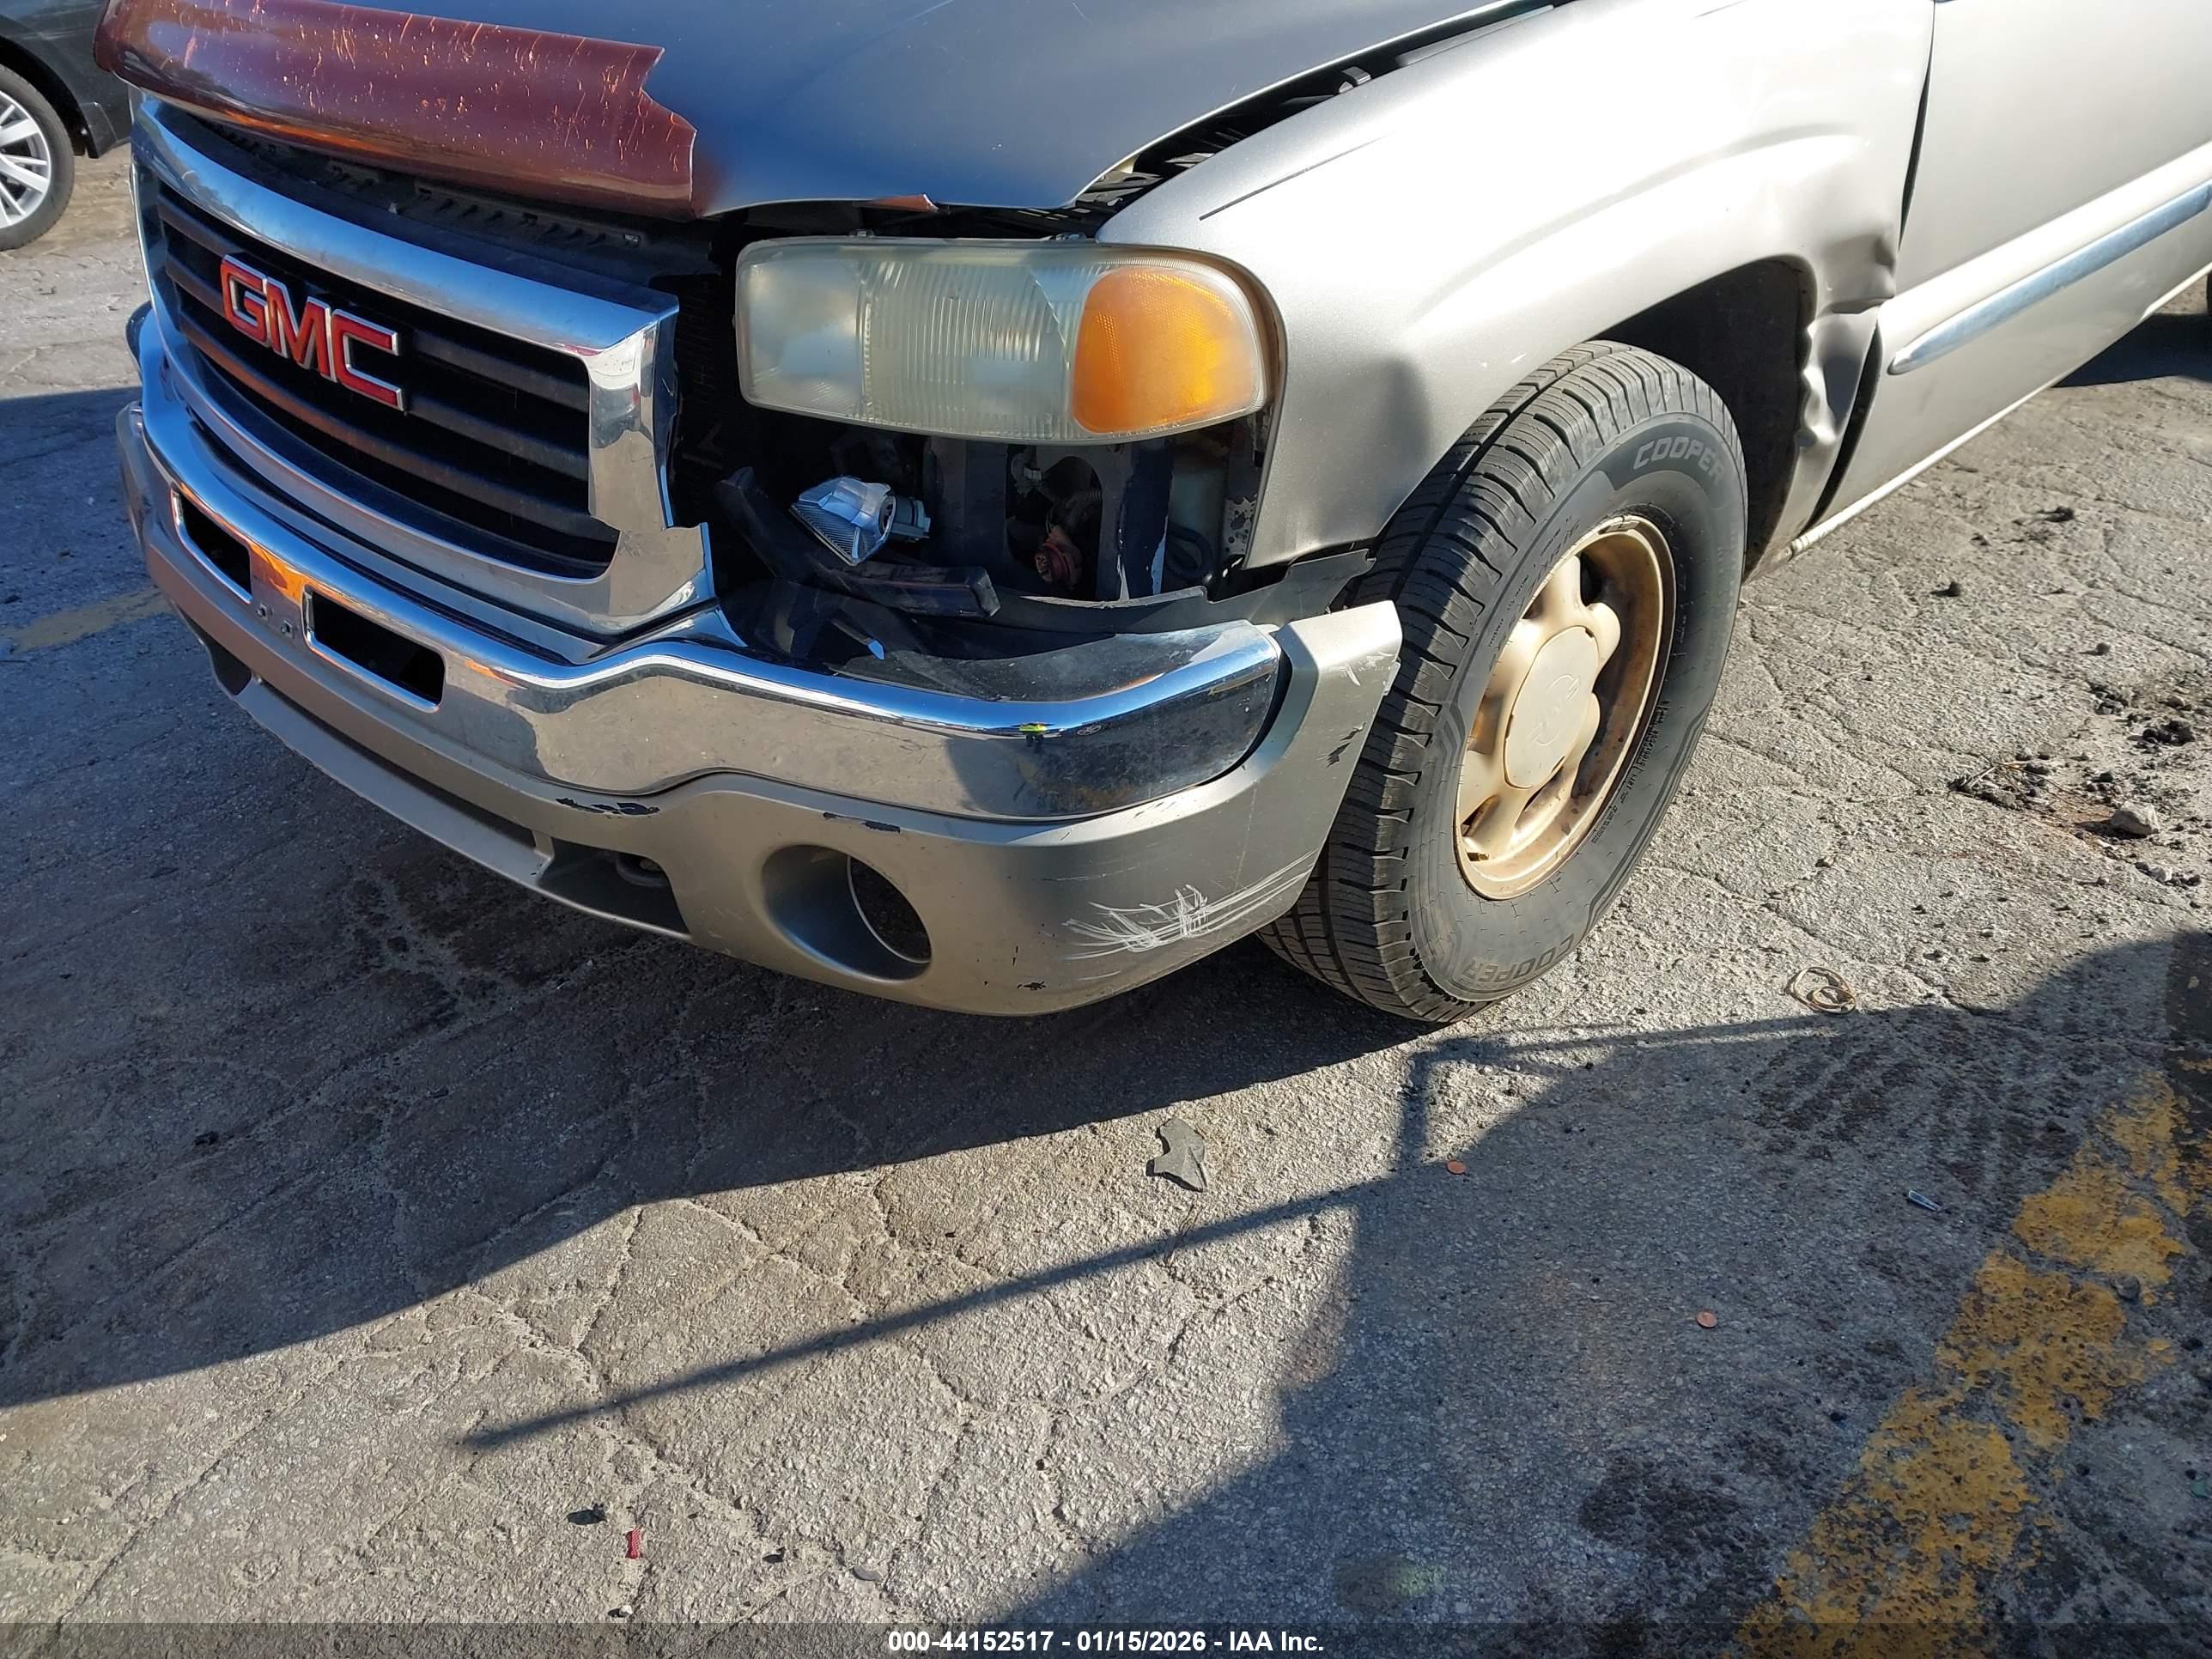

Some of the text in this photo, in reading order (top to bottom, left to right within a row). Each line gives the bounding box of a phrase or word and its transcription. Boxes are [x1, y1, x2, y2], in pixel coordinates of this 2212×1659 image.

[220, 254, 404, 412] GMC
[1632, 436, 1723, 487] COOPER
[1462, 933, 1575, 983] COOPER
